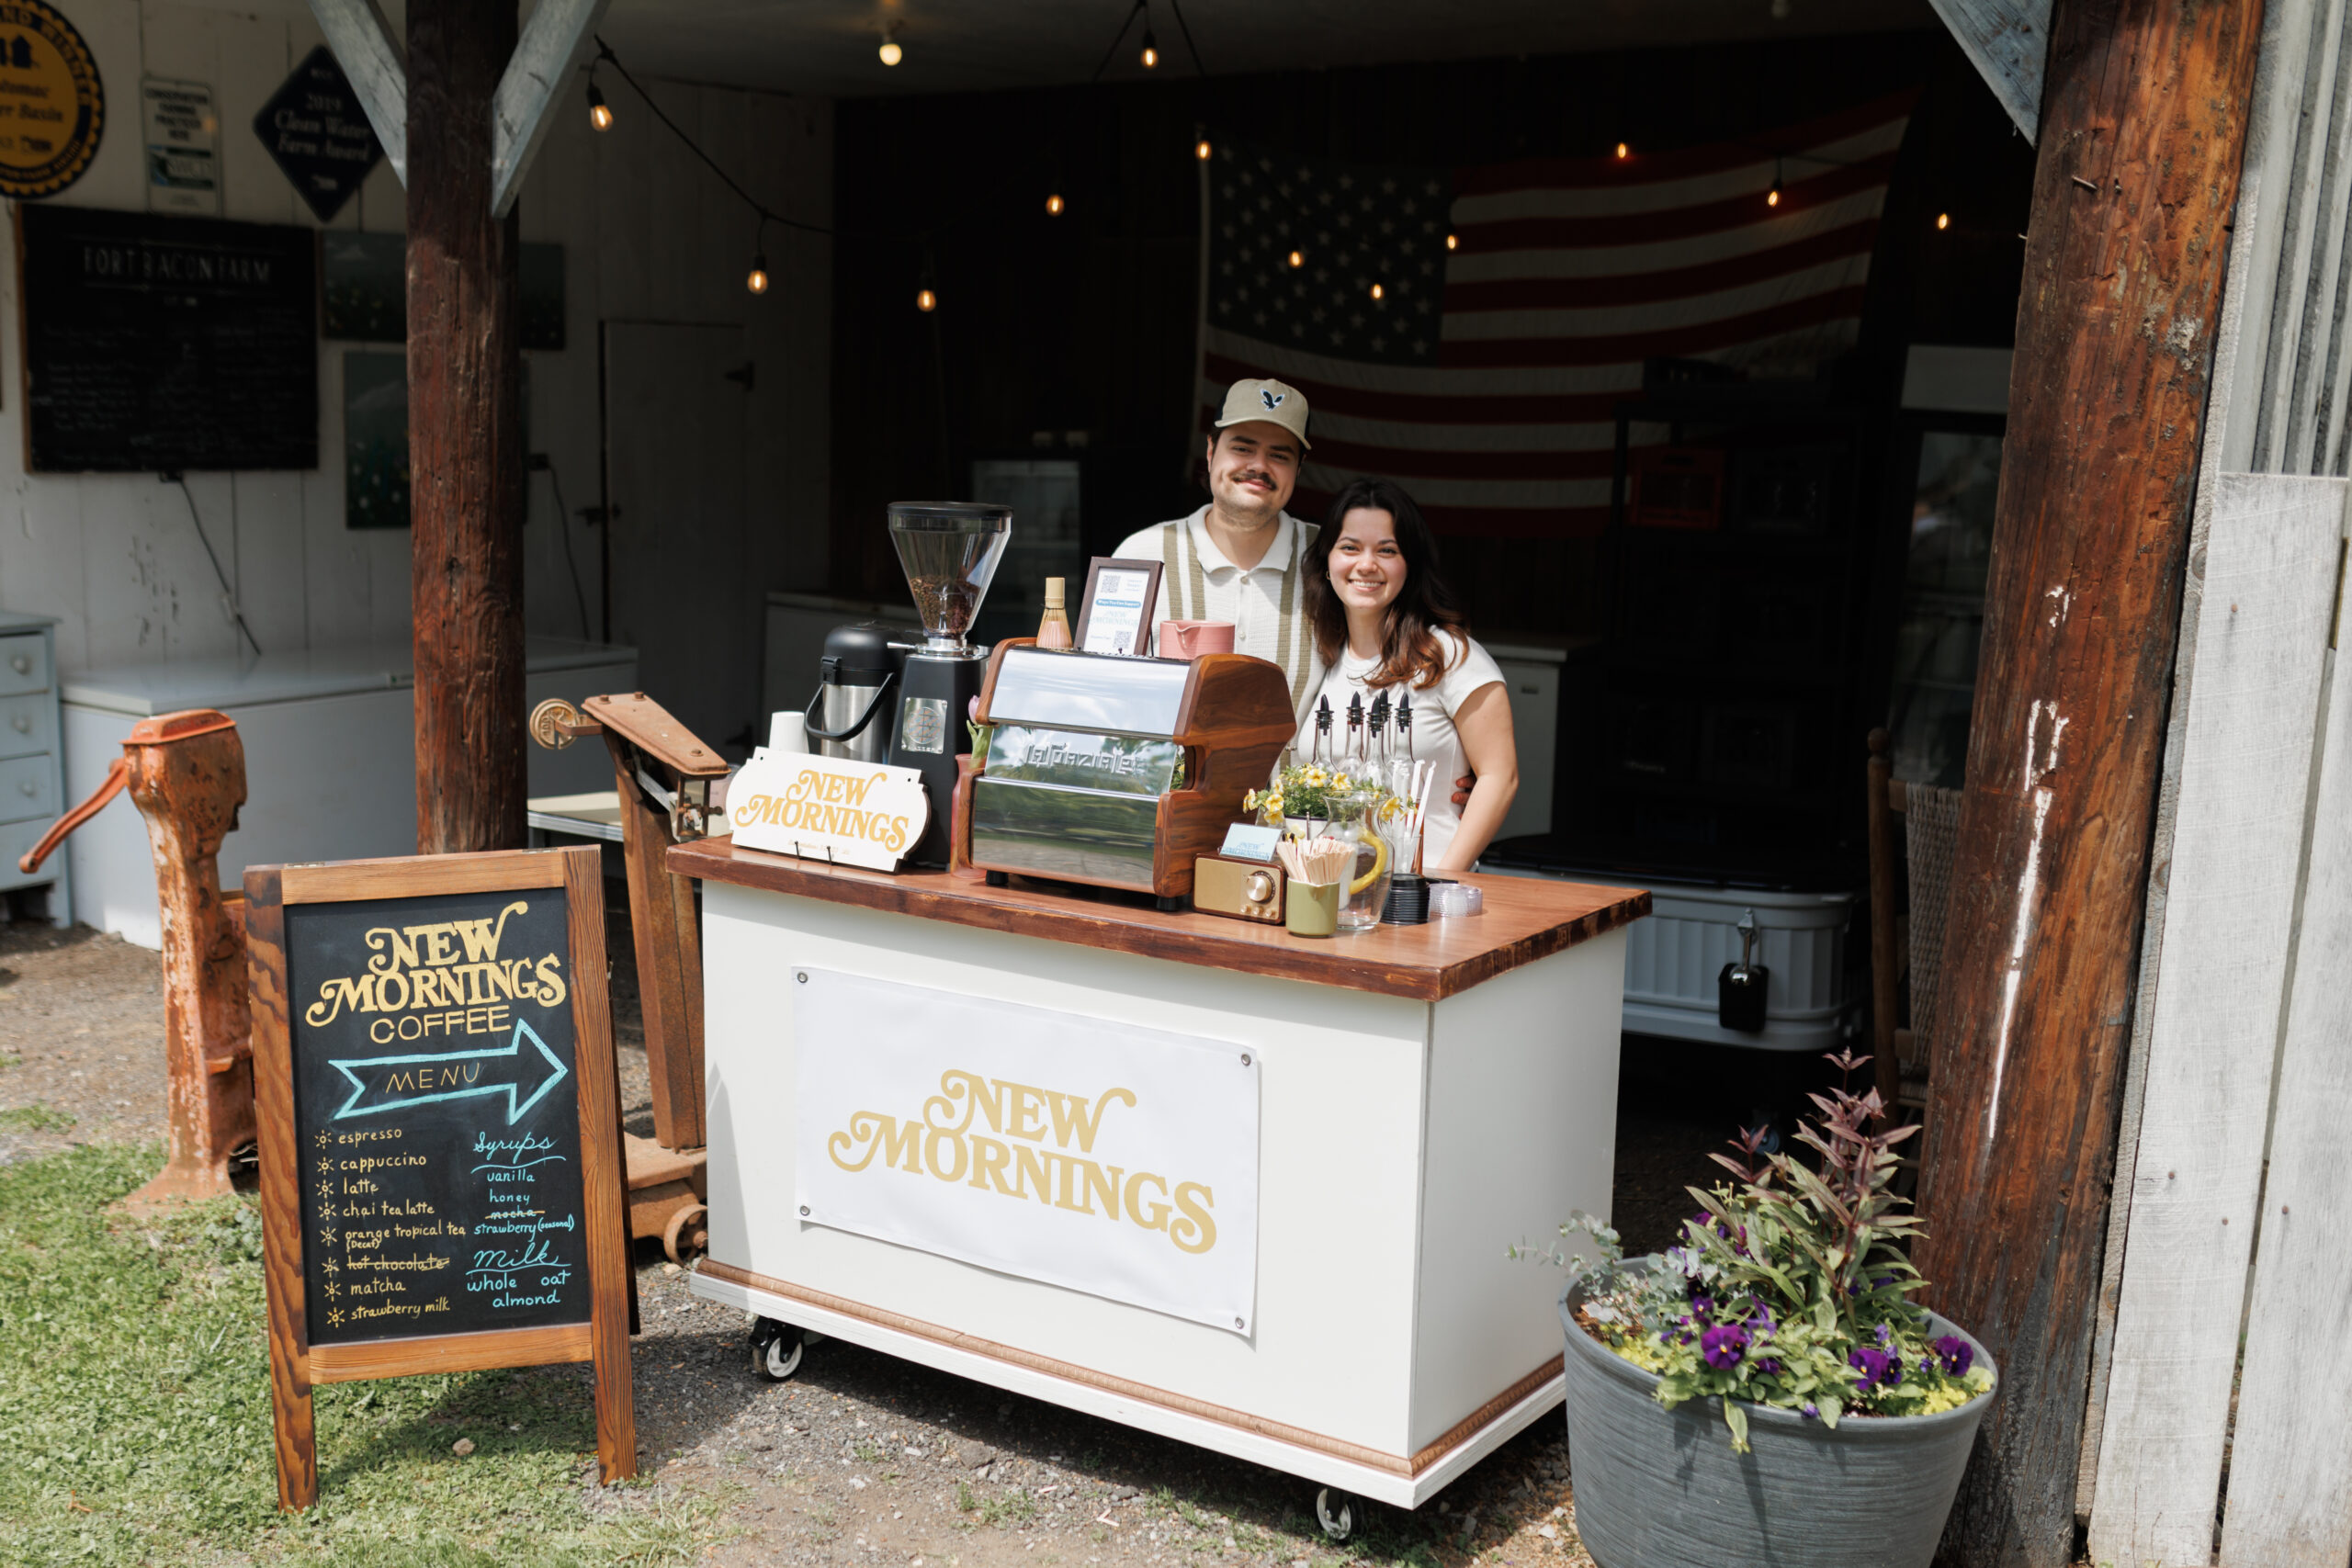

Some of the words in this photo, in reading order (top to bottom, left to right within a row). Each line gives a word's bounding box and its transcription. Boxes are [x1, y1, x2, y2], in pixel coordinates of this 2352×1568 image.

[304, 92, 345, 112] 2019
[274, 108, 322, 134] Clean
[324, 115, 372, 139] Water
[277, 132, 319, 156] Farm
[325, 138, 372, 163] Award
[82, 245, 135, 276] FORT
[141, 251, 213, 282] BACON
[218, 256, 271, 284] FARM
[786, 769, 887, 807] NEW
[734, 794, 910, 852] MORNINGS
[365, 900, 528, 976] NEW
[305, 952, 567, 1027] MORNINGS
[369, 1004, 512, 1044] COFFEE
[386, 1062, 481, 1094] MENU
[922, 1068, 1137, 1154] NEW
[338, 1129, 402, 1147] espresso
[473, 1131, 559, 1164] Syrups
[340, 1153, 426, 1173] cappuccino
[486, 1168, 536, 1182] vanilla
[344, 1178, 379, 1195] latte
[828, 1110, 1218, 1255] MORNINGS
[343, 1201, 376, 1218] chai
[381, 1201, 401, 1216] tea
[406, 1199, 435, 1215] latte
[489, 1189, 531, 1205] honey
[345, 1226, 390, 1243] orange
[395, 1219, 443, 1237] tropical
[447, 1222, 466, 1235] tea
[474, 1218, 537, 1243] strawberry
[537, 1213, 575, 1234] (seasonal)
[346, 1237, 381, 1253] (Decaf)
[350, 1277, 407, 1295] matcha
[467, 1273, 517, 1292] whole
[540, 1269, 571, 1286] oat
[351, 1299, 421, 1322] strawberry
[424, 1296, 450, 1312] milk
[492, 1290, 561, 1308] almond
